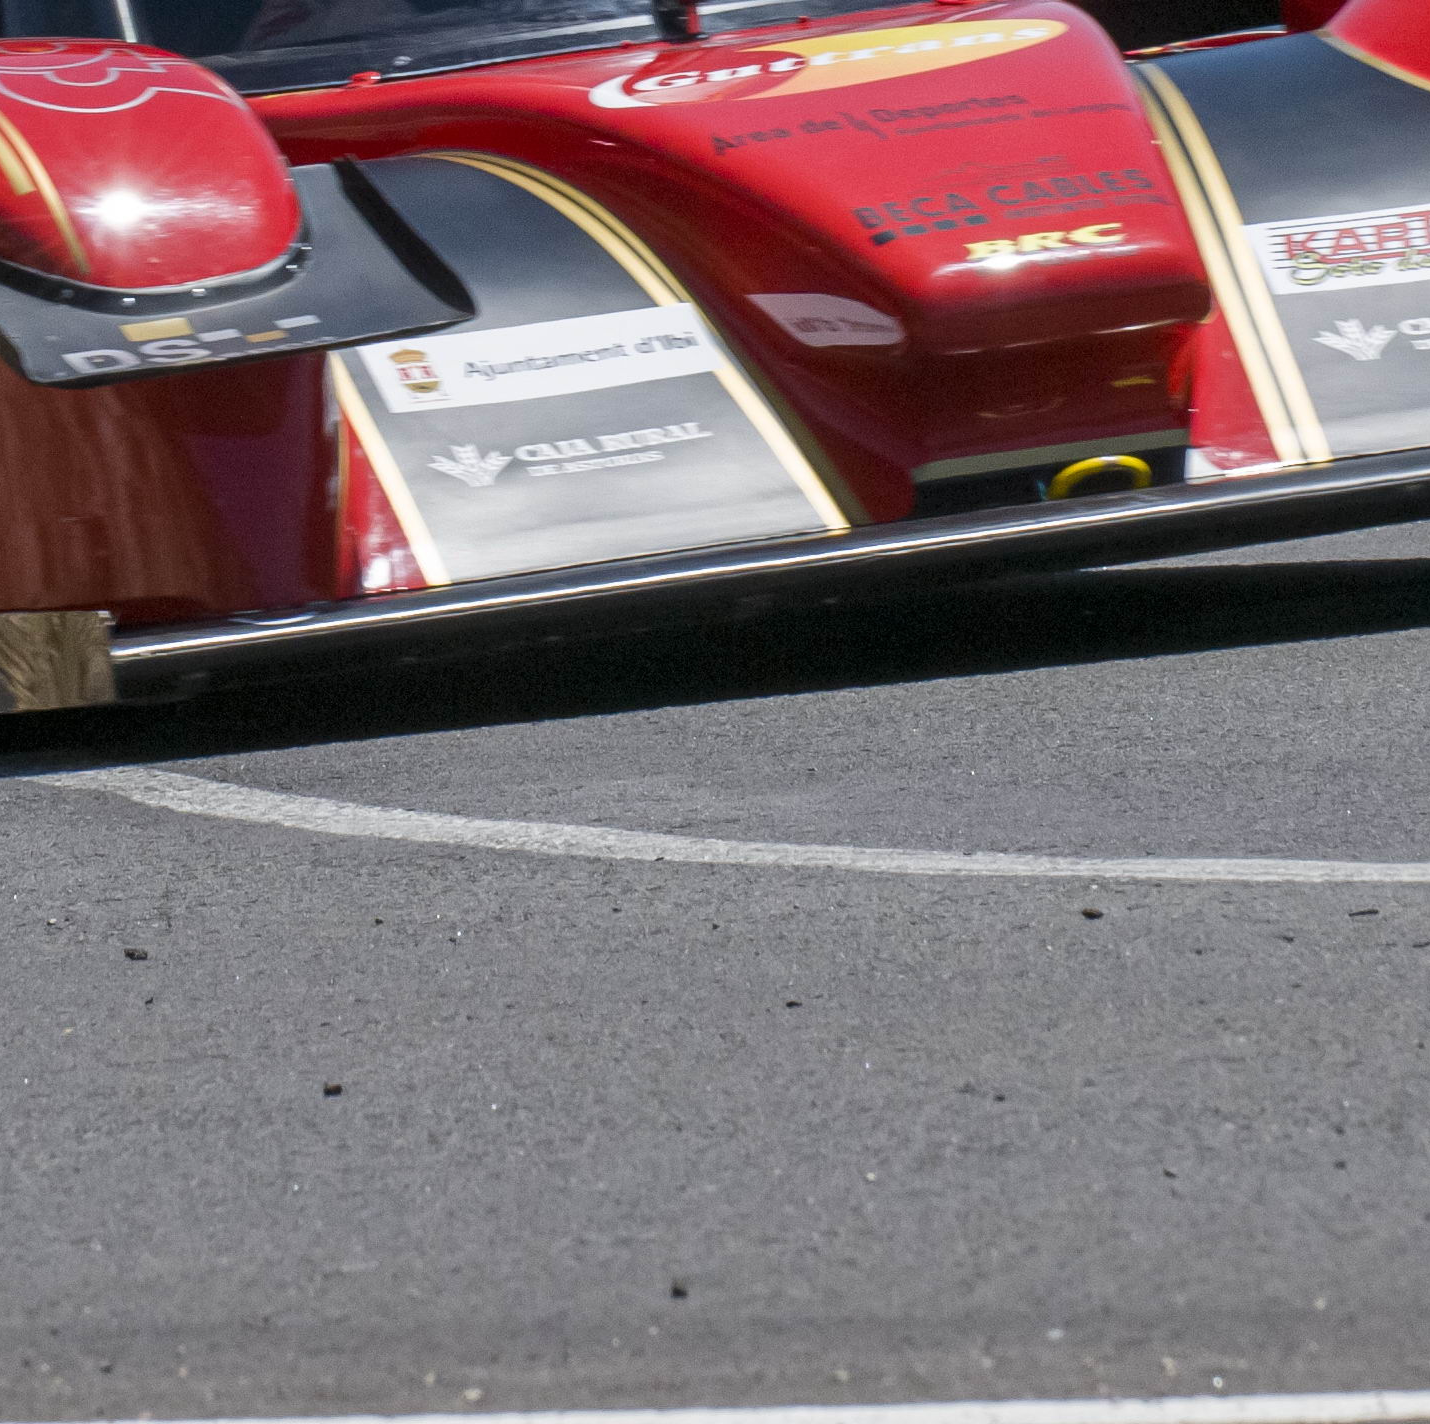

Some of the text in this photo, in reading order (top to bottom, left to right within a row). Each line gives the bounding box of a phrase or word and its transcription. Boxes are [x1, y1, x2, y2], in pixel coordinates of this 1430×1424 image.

[852, 192, 982, 229] BECA
[986, 168, 1154, 206] CABLES
[962, 222, 1128, 261] BRC
[463, 343, 629, 381] Ajuntament
